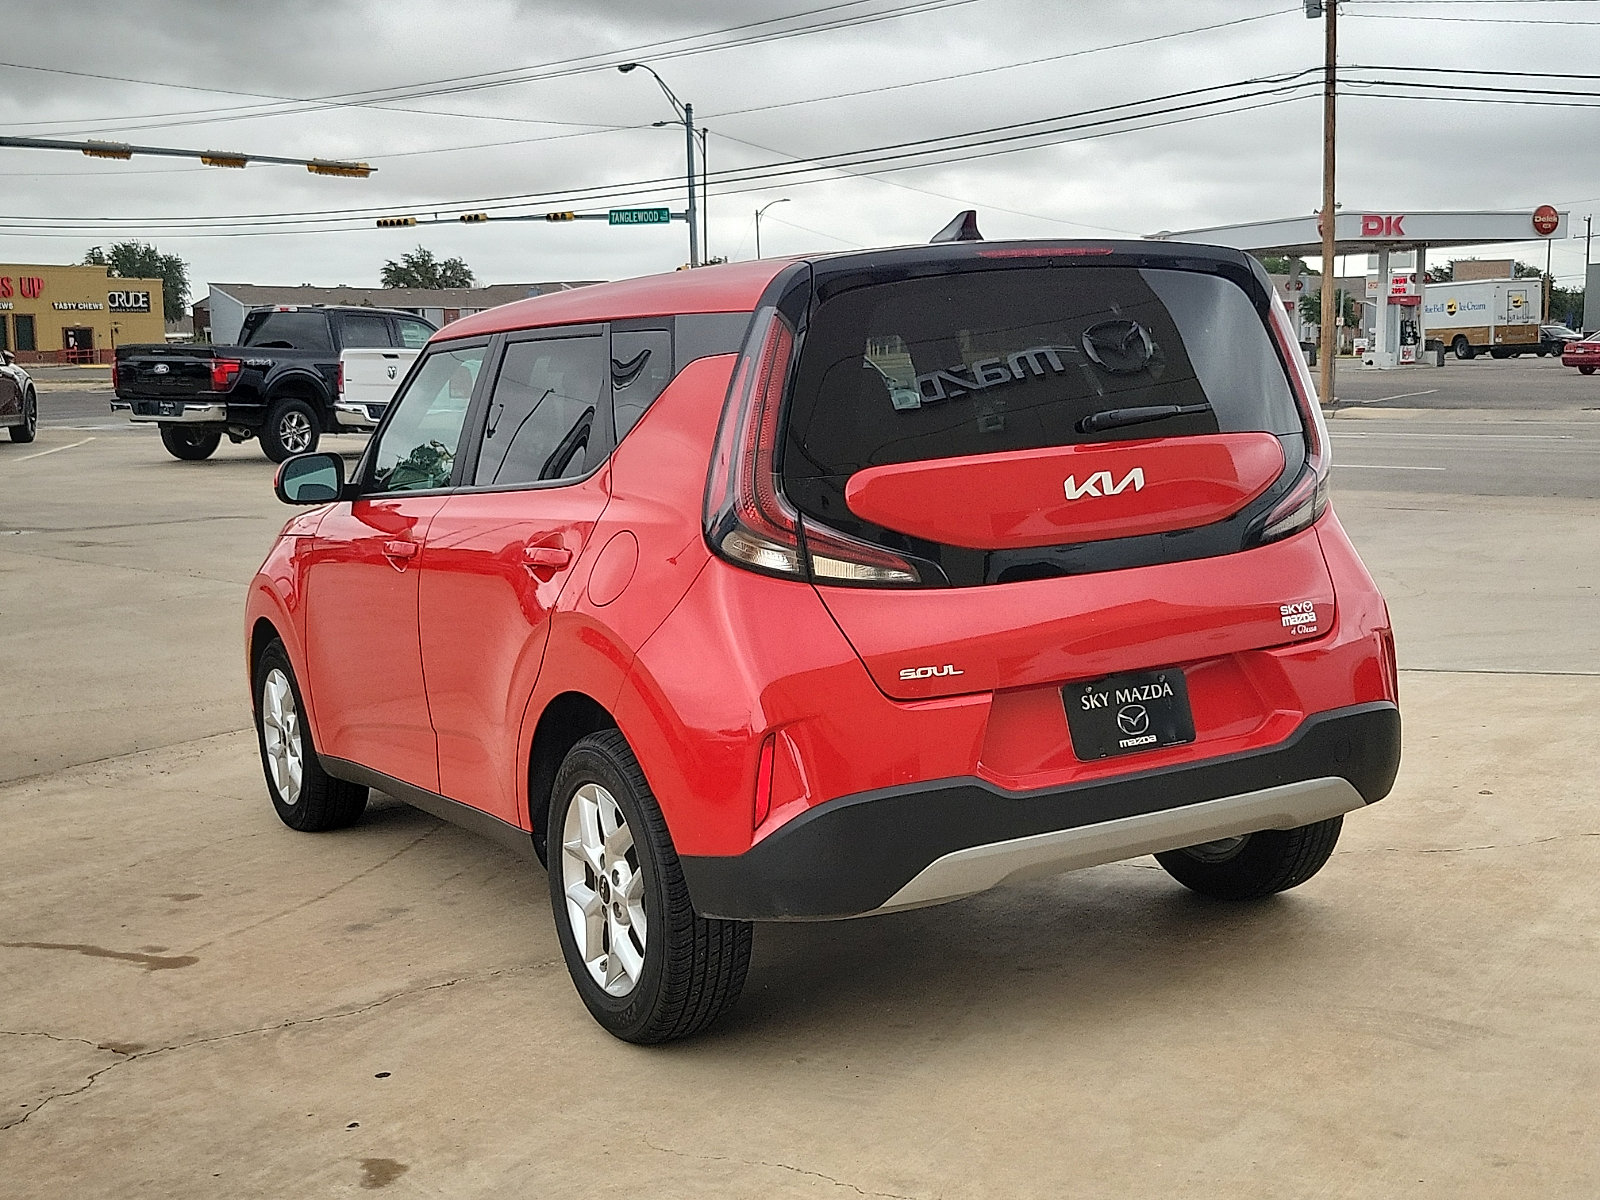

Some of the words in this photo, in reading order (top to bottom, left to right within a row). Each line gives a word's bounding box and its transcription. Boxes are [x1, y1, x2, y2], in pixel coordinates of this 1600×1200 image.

[610, 201, 659, 213] TANGLEWOOD
[1361, 215, 1405, 236] DK
[20, 276, 45, 299] UP
[54, 302, 77, 310] TASTY
[78, 302, 104, 310] CHEWS
[108, 291, 149, 307] CRUDE
[1063, 467, 1145, 500] KIA
[1279, 602, 1303, 616] SKY
[1281, 611, 1317, 627] mazda
[899, 664, 965, 681] SOUL
[1080, 691, 1109, 711] SKY
[1115, 682, 1174, 705] MAZDA
[1118, 734, 1158, 748] mazda
